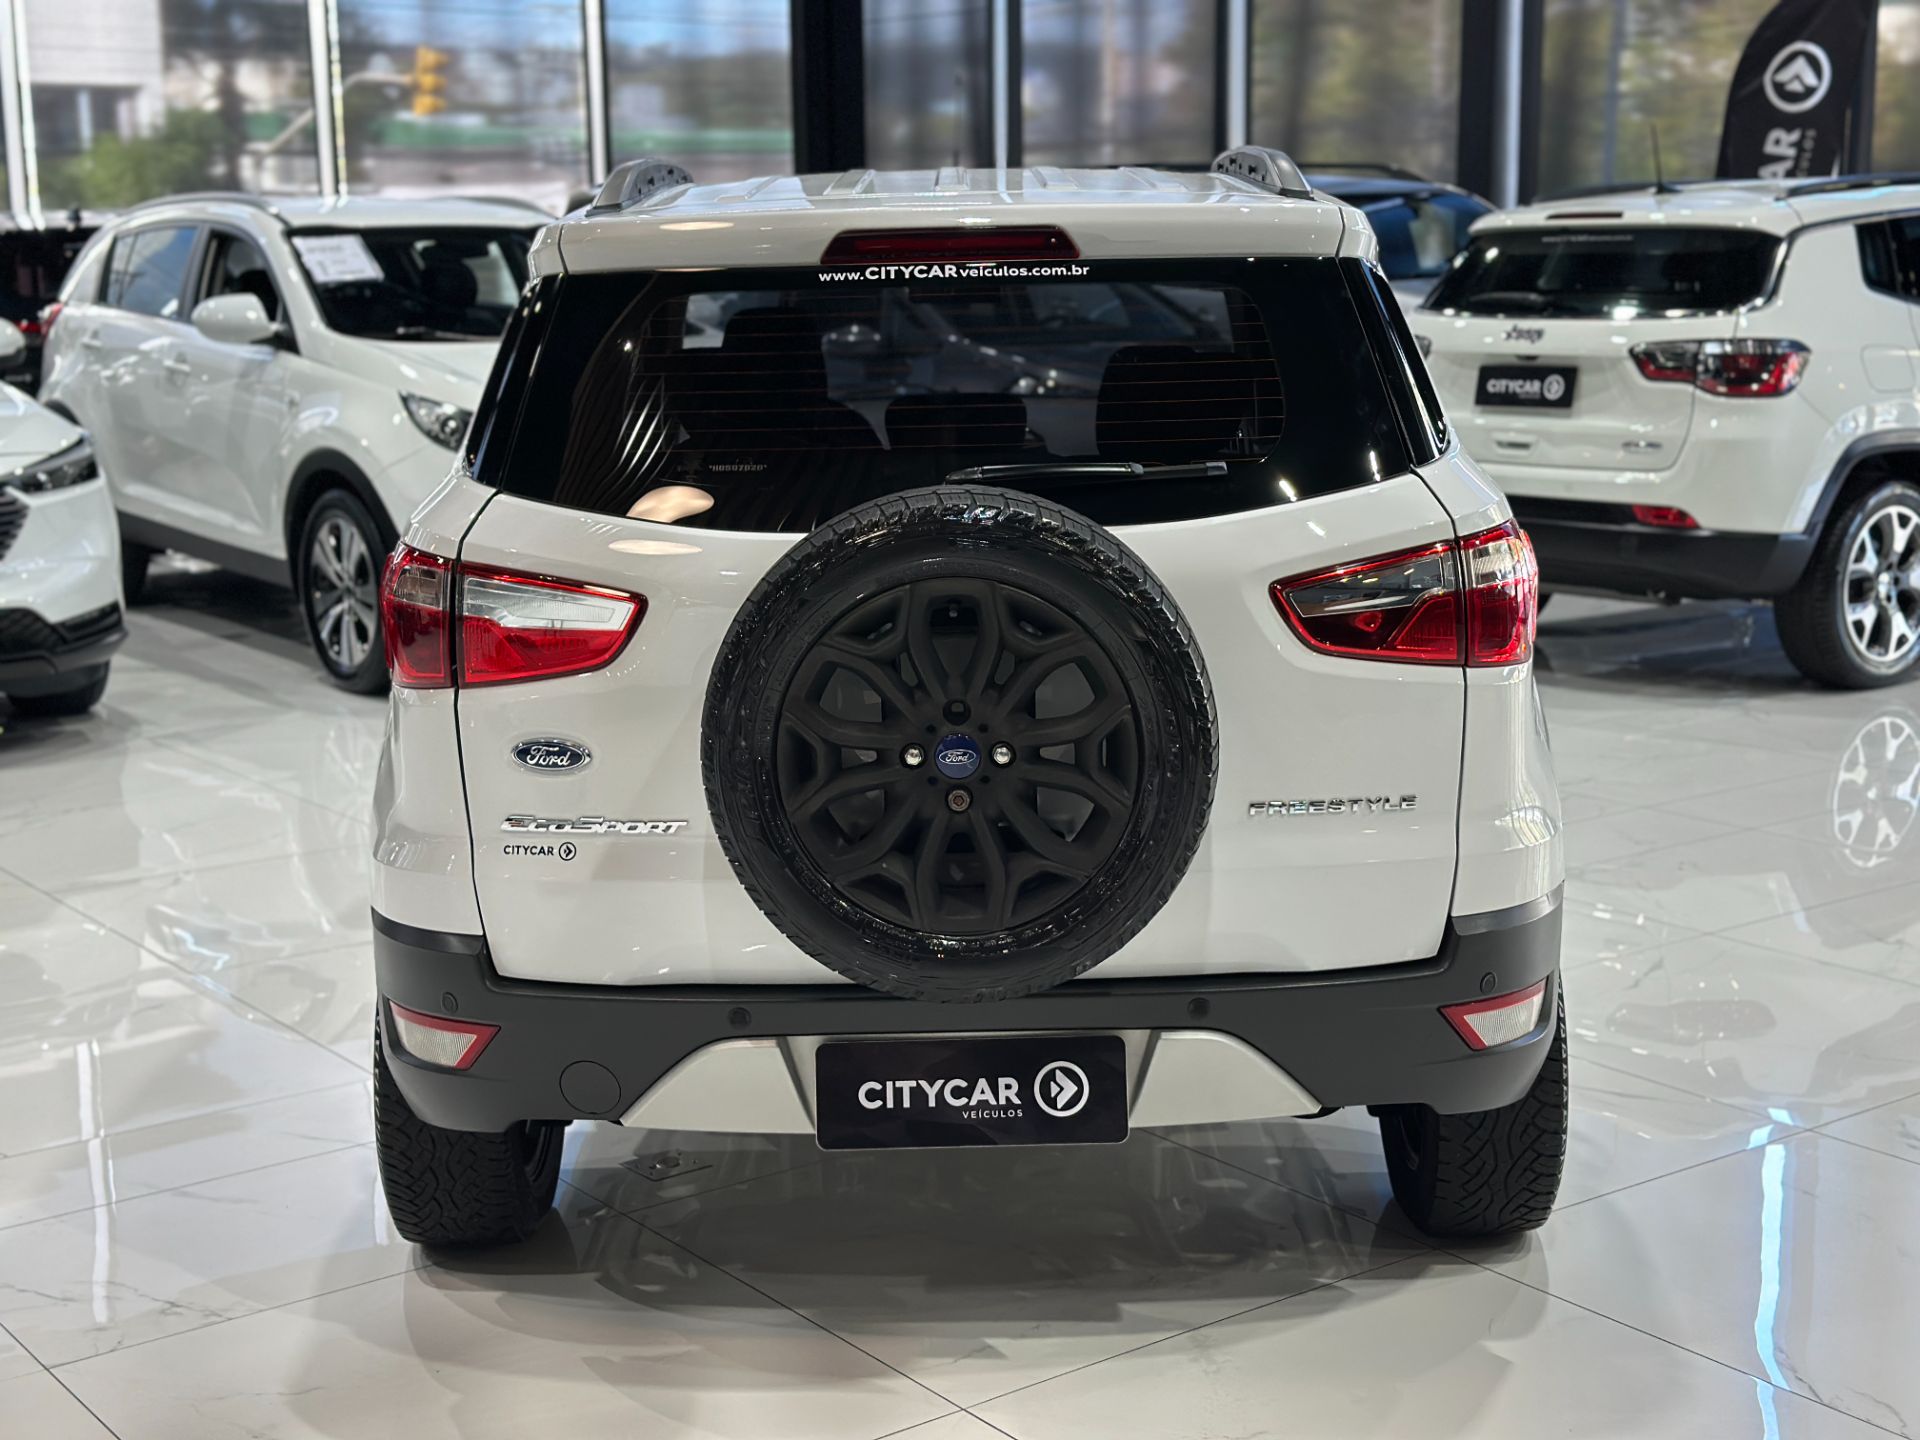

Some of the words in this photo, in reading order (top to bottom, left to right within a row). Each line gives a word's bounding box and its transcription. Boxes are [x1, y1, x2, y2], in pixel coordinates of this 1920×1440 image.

[1486, 378, 1541, 394] CITYCAR
[526, 745, 572, 766] Ford
[945, 751, 970, 762] Ford
[1249, 794, 1418, 816] FREESTYLE
[503, 844, 554, 856] CITYCAR
[858, 1076, 1022, 1110] CITYCAR
[962, 1108, 1023, 1120] VEÍCULOS
